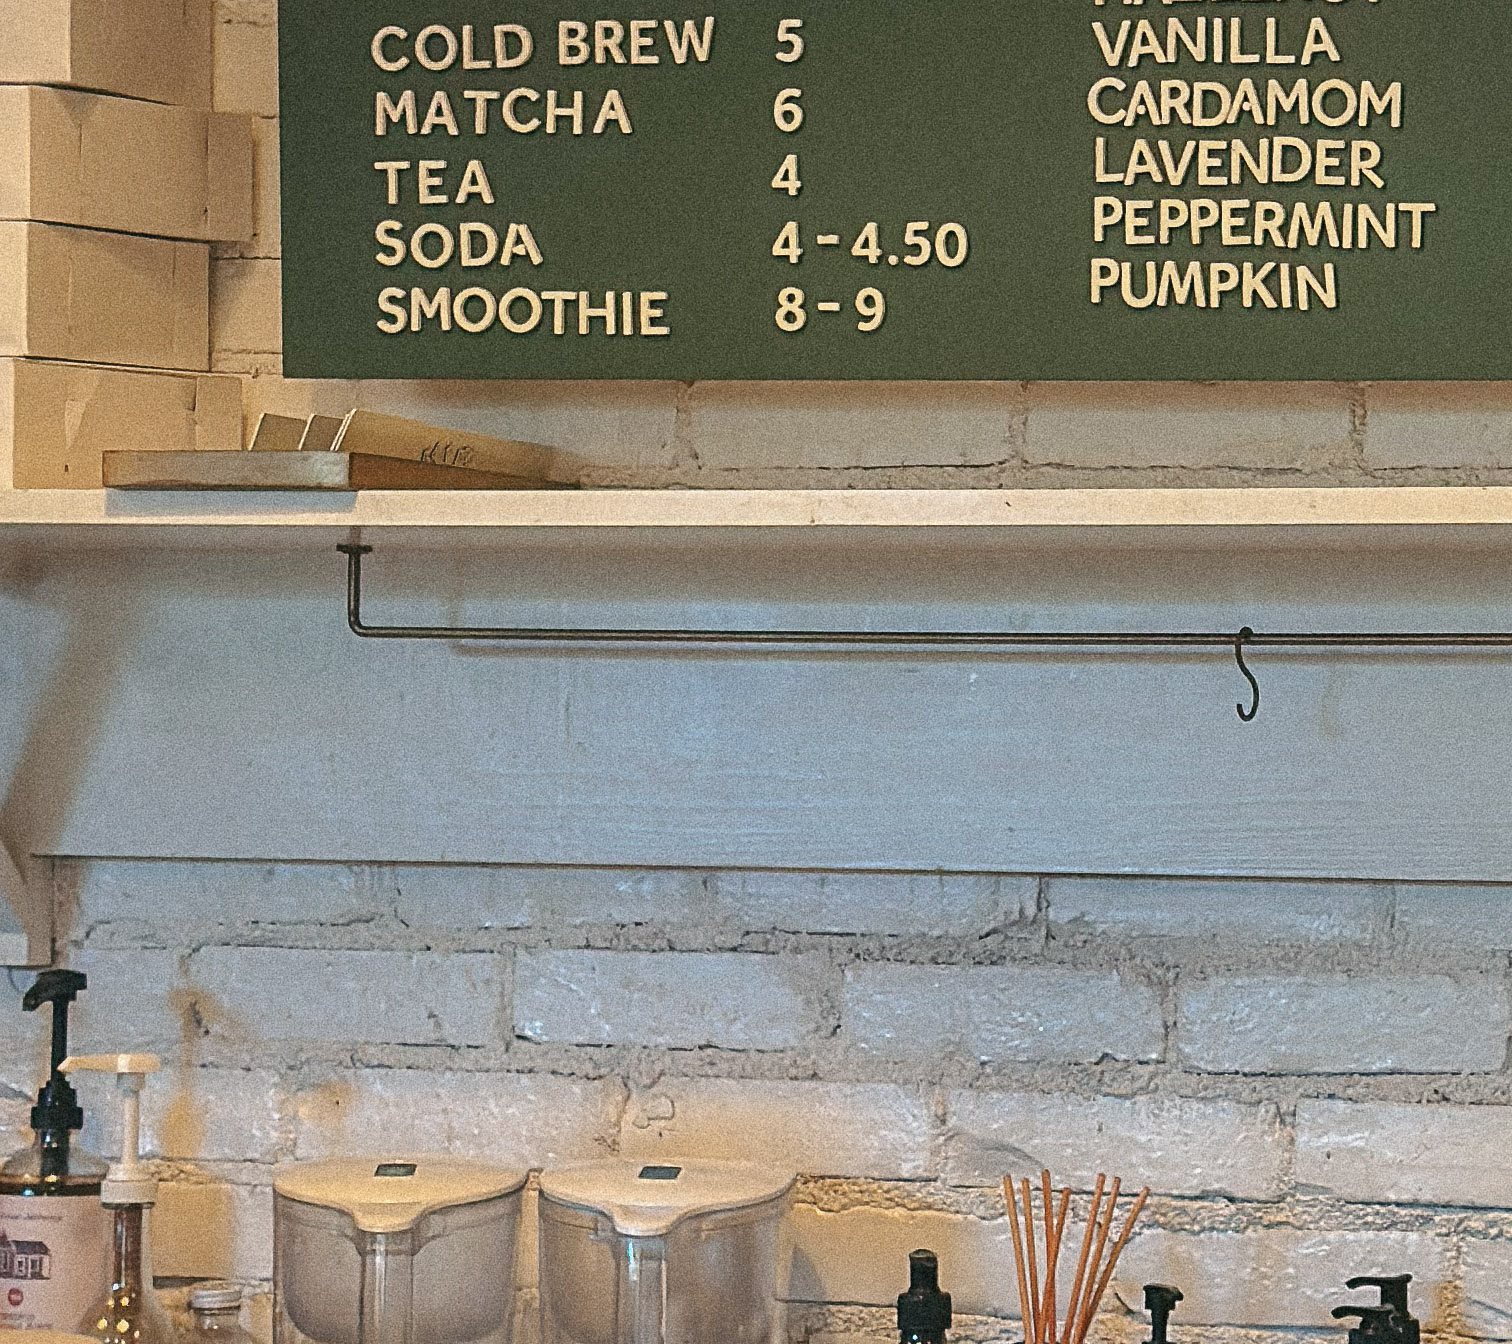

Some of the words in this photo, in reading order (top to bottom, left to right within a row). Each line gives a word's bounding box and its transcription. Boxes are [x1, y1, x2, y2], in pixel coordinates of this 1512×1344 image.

[370, 22, 533, 73] COLD
[557, 14, 716, 66] BREW
[774, 17, 805, 64] 5
[1090, 14, 1342, 69] VANILLA
[374, 85, 634, 137] MATCHA
[772, 86, 804, 133] 6
[1085, 75, 1403, 129] CARDAMOM
[372, 158, 496, 206] TEA
[769, 152, 803, 197] 4
[1093, 134, 1386, 190] LAVENDER
[373, 218, 545, 270] SODA
[1092, 194, 1437, 250] PEPPERMINT
[375, 285, 671, 337] SMOOTHIE
[773, 285, 886, 333] 8-9
[1089, 256, 1338, 312] PUMPKIN
